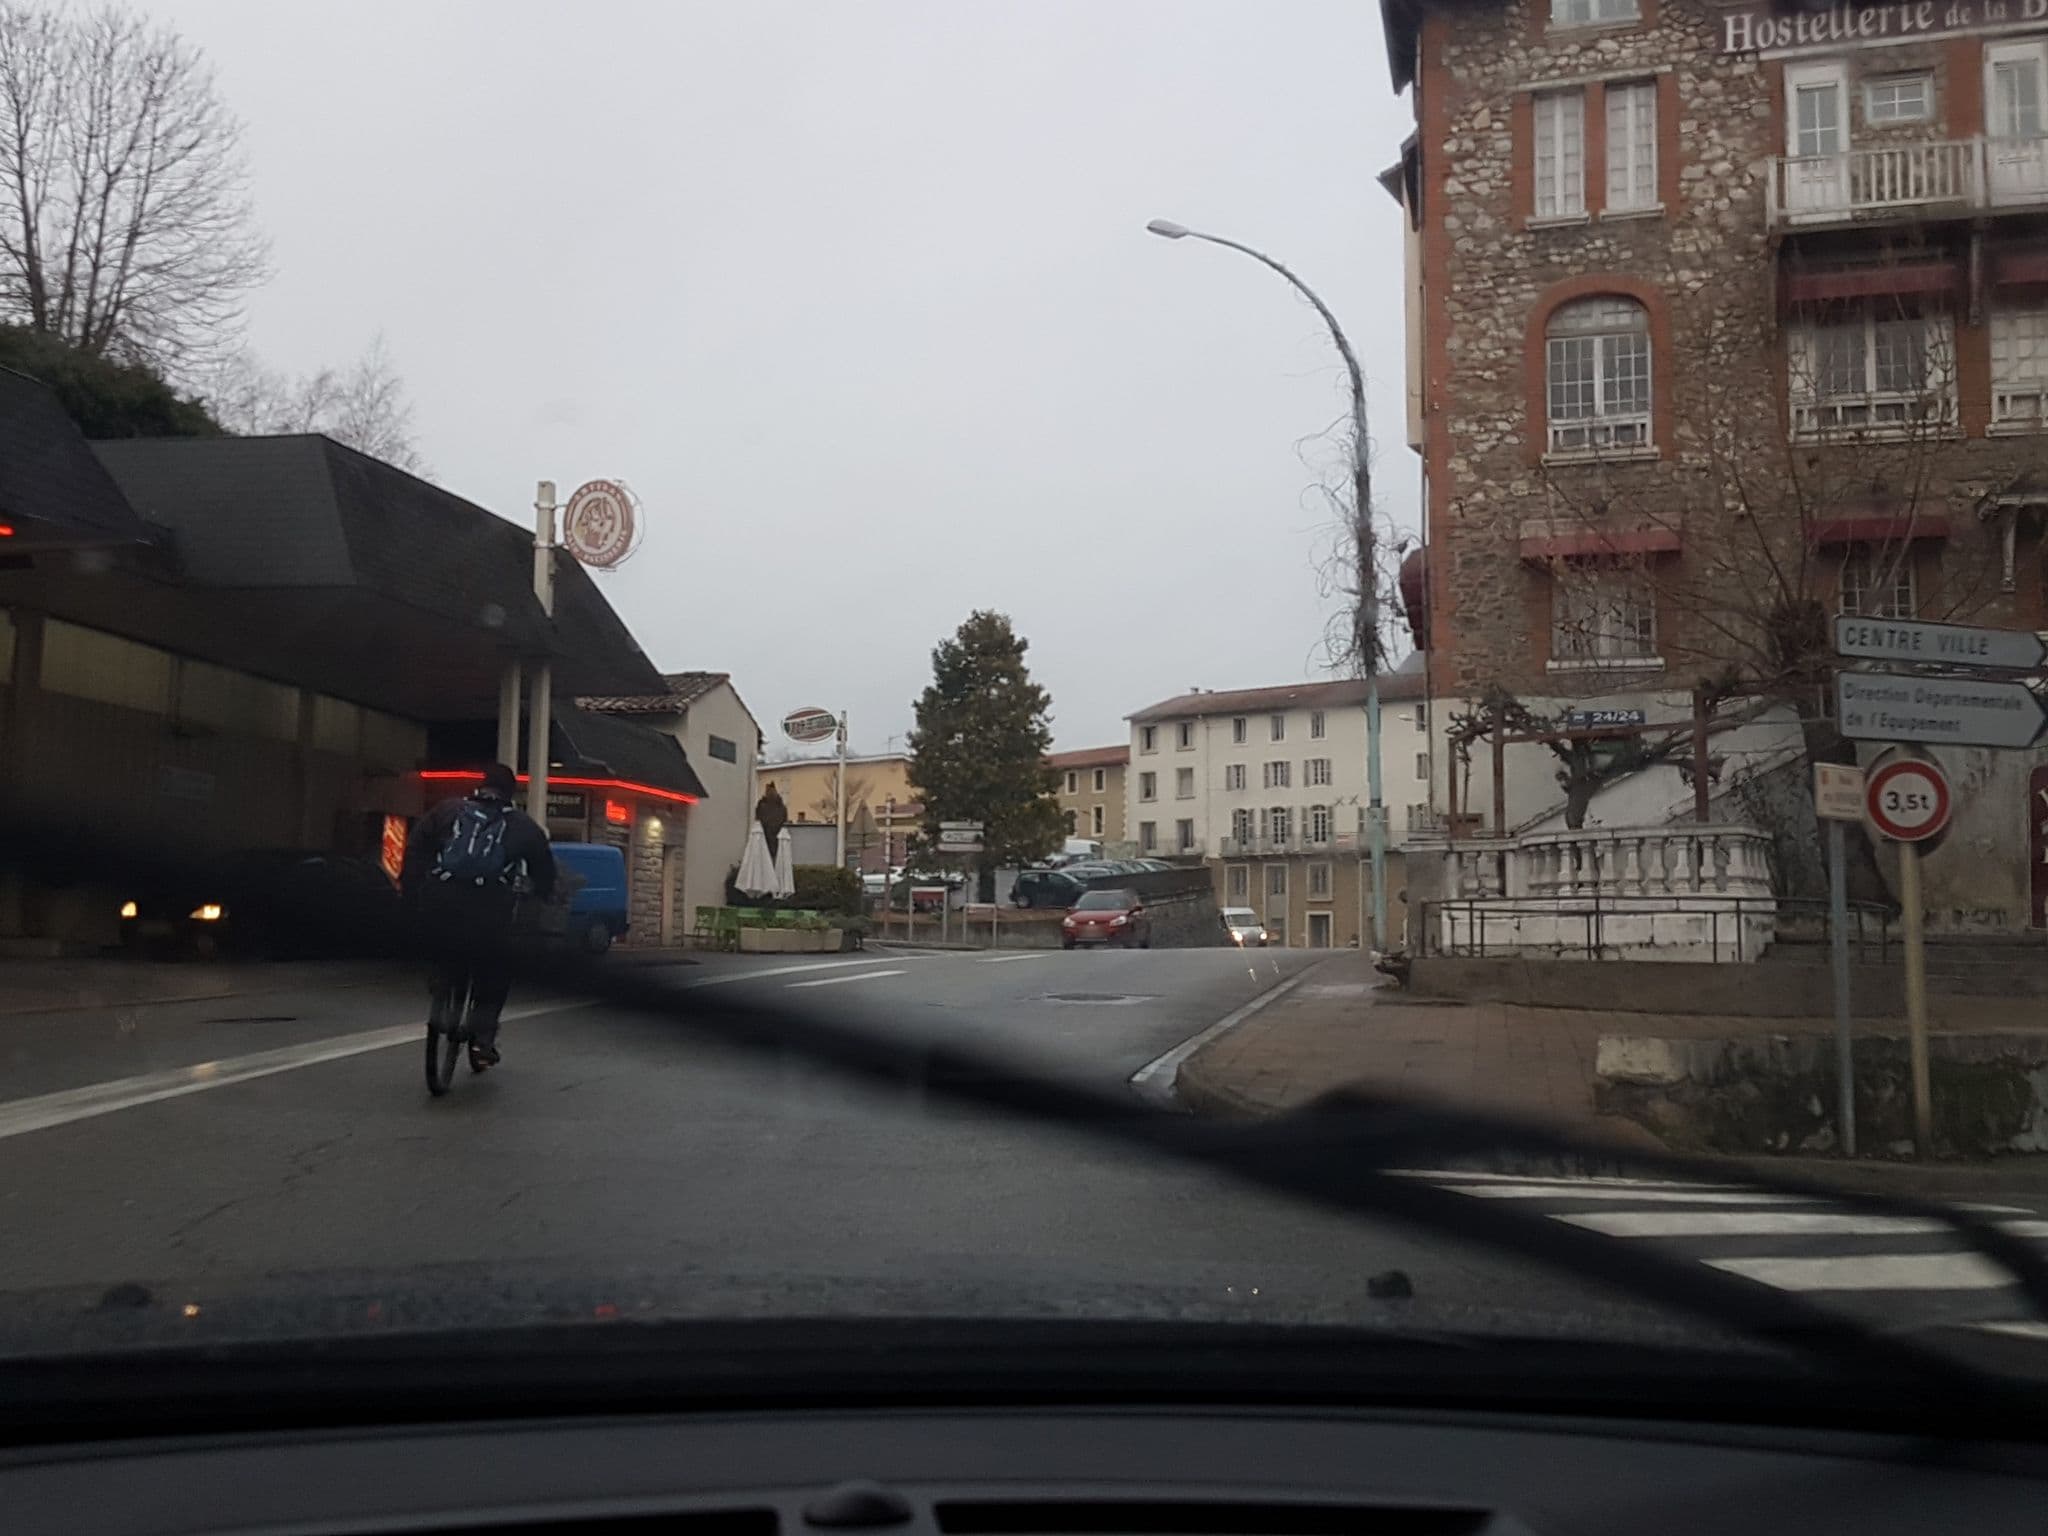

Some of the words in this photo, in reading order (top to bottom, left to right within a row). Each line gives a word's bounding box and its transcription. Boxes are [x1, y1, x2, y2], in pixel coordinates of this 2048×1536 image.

[1722, 0, 1936, 53] Hostellerie
[1945, 3, 1970, 28] de
[1846, 627, 1923, 651] CENTRE
[1937, 634, 1991, 656] VILLE
[1844, 682, 1910, 701] Direction
[1847, 711, 1863, 727] de
